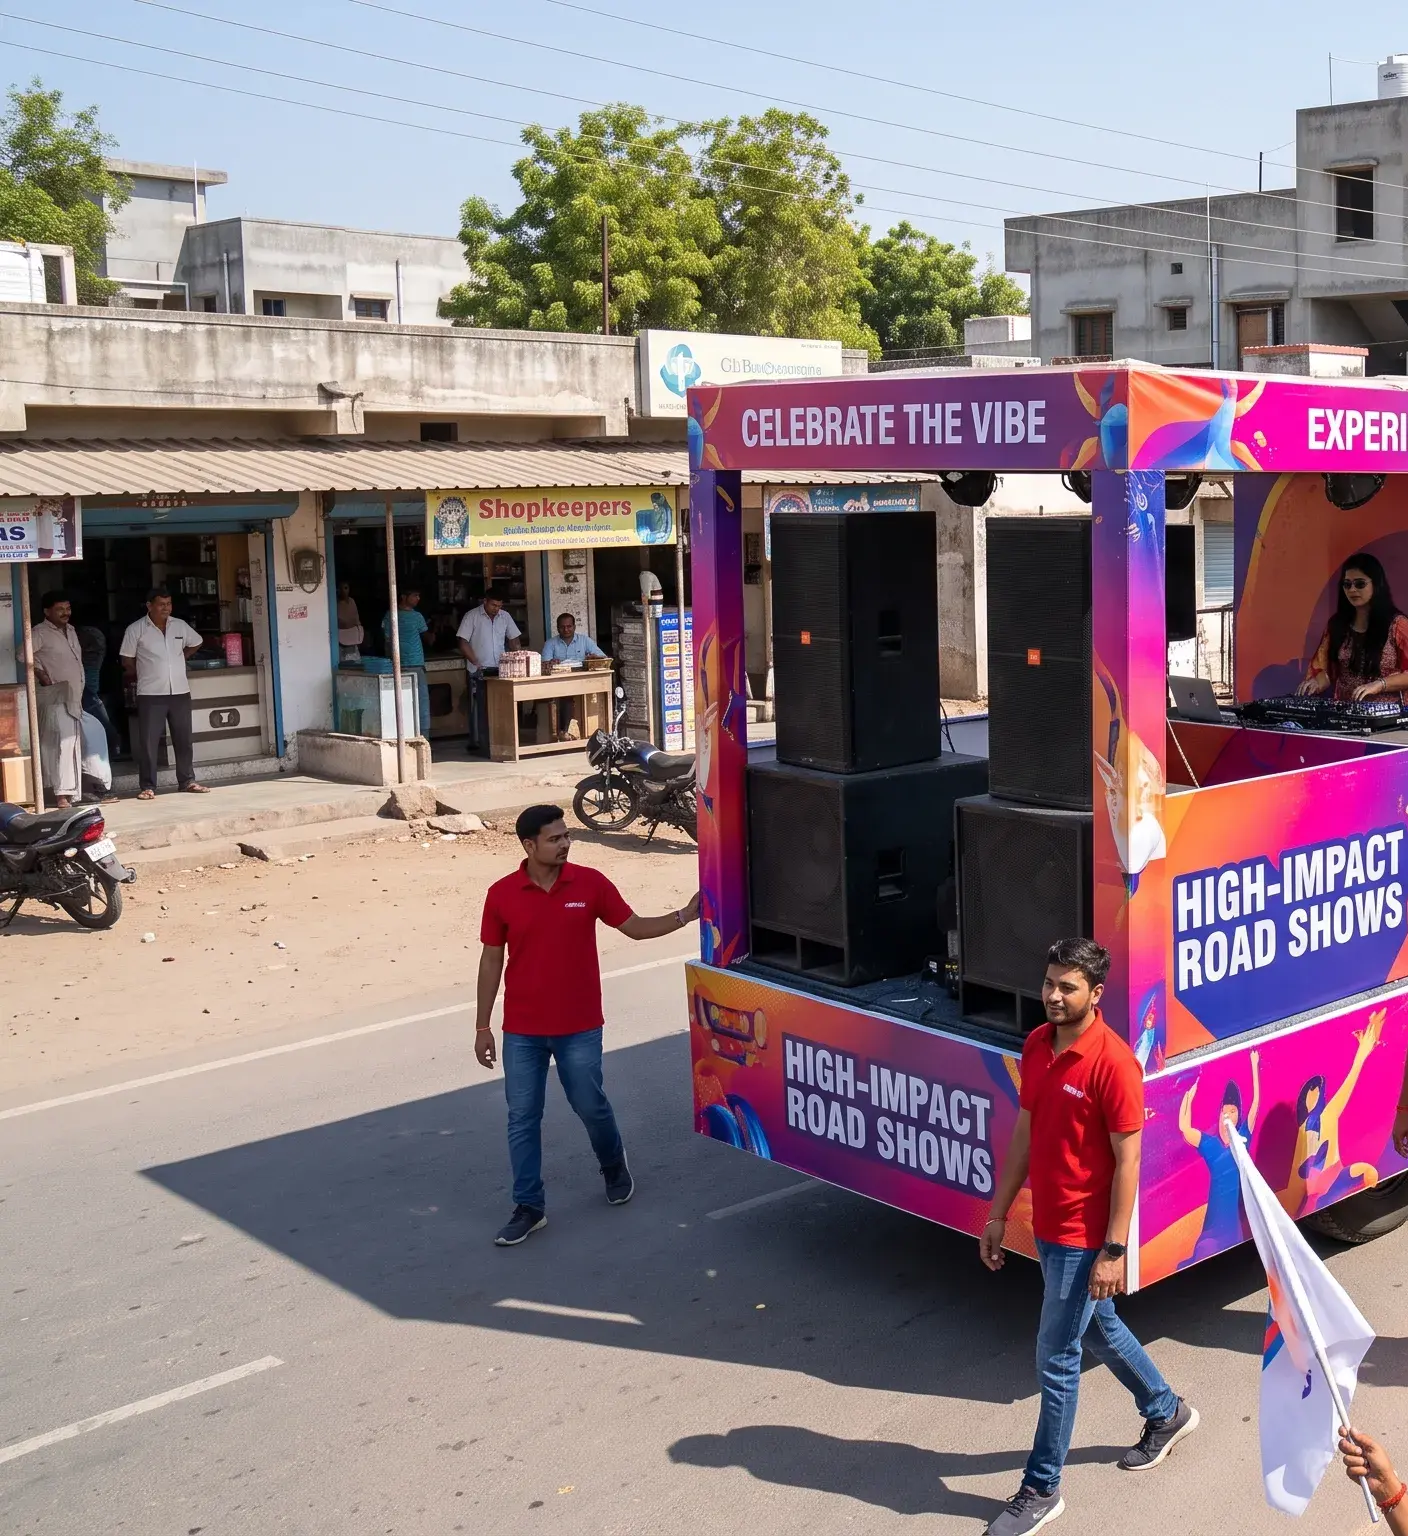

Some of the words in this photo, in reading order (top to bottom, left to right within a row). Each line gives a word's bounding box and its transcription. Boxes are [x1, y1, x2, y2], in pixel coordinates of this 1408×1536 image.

[741, 404, 895, 447] CELEBRATE
[903, 401, 962, 445] THE
[971, 400, 1047, 444] VIBE
[478, 497, 632, 523] Shopkeepers
[1177, 829, 1405, 933] HIGH-IMPACT
[1178, 918, 1277, 992] ROAD
[1288, 882, 1403, 958] SHOWS
[785, 1039, 992, 1142] HIGH-IMPACT
[787, 1086, 866, 1150] ROAD
[877, 1116, 993, 1194] SHOWS
